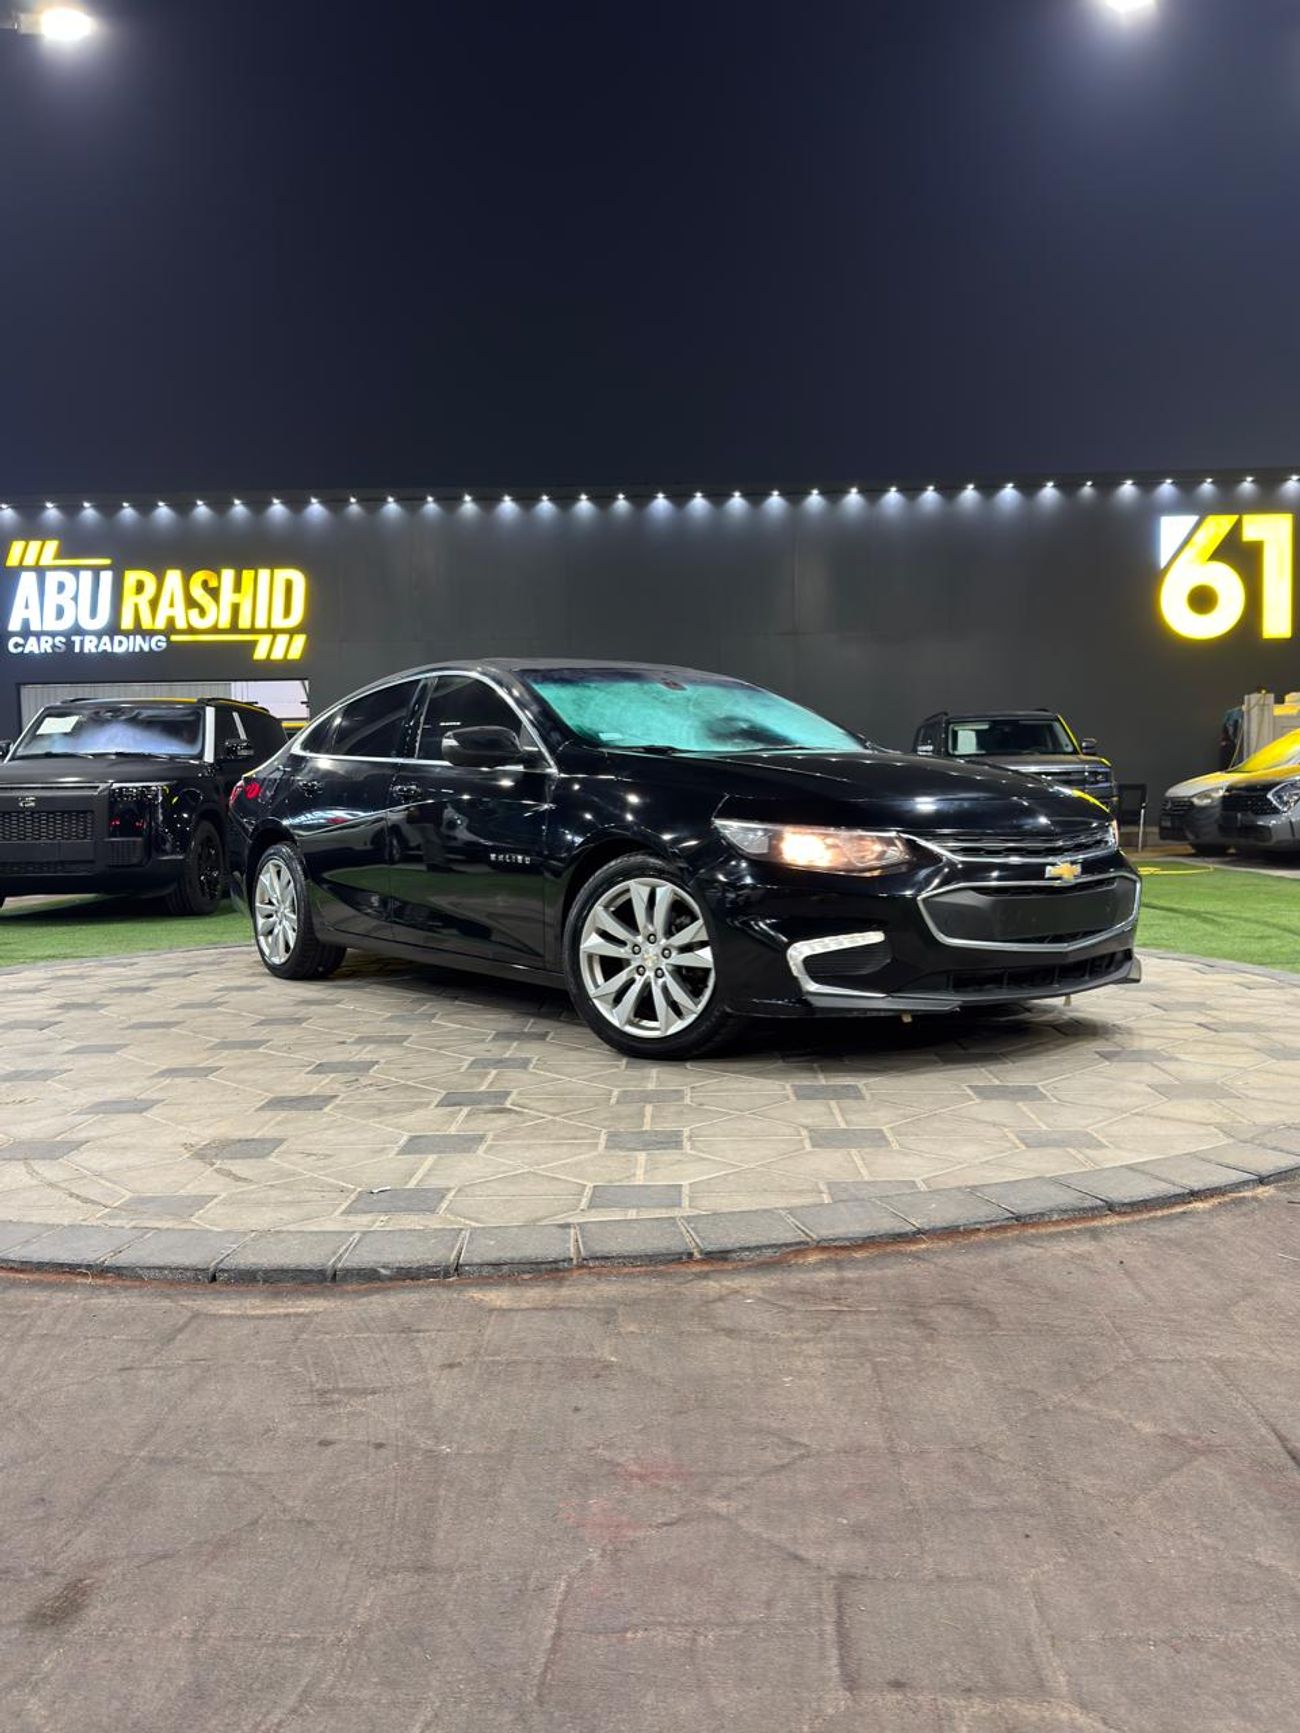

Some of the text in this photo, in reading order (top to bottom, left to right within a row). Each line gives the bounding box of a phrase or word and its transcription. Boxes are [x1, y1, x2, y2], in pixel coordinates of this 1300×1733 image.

[8, 568, 307, 631] ABU RASHID
[1160, 514, 1293, 640] 61
[8, 634, 168, 654] CARS TRADING
